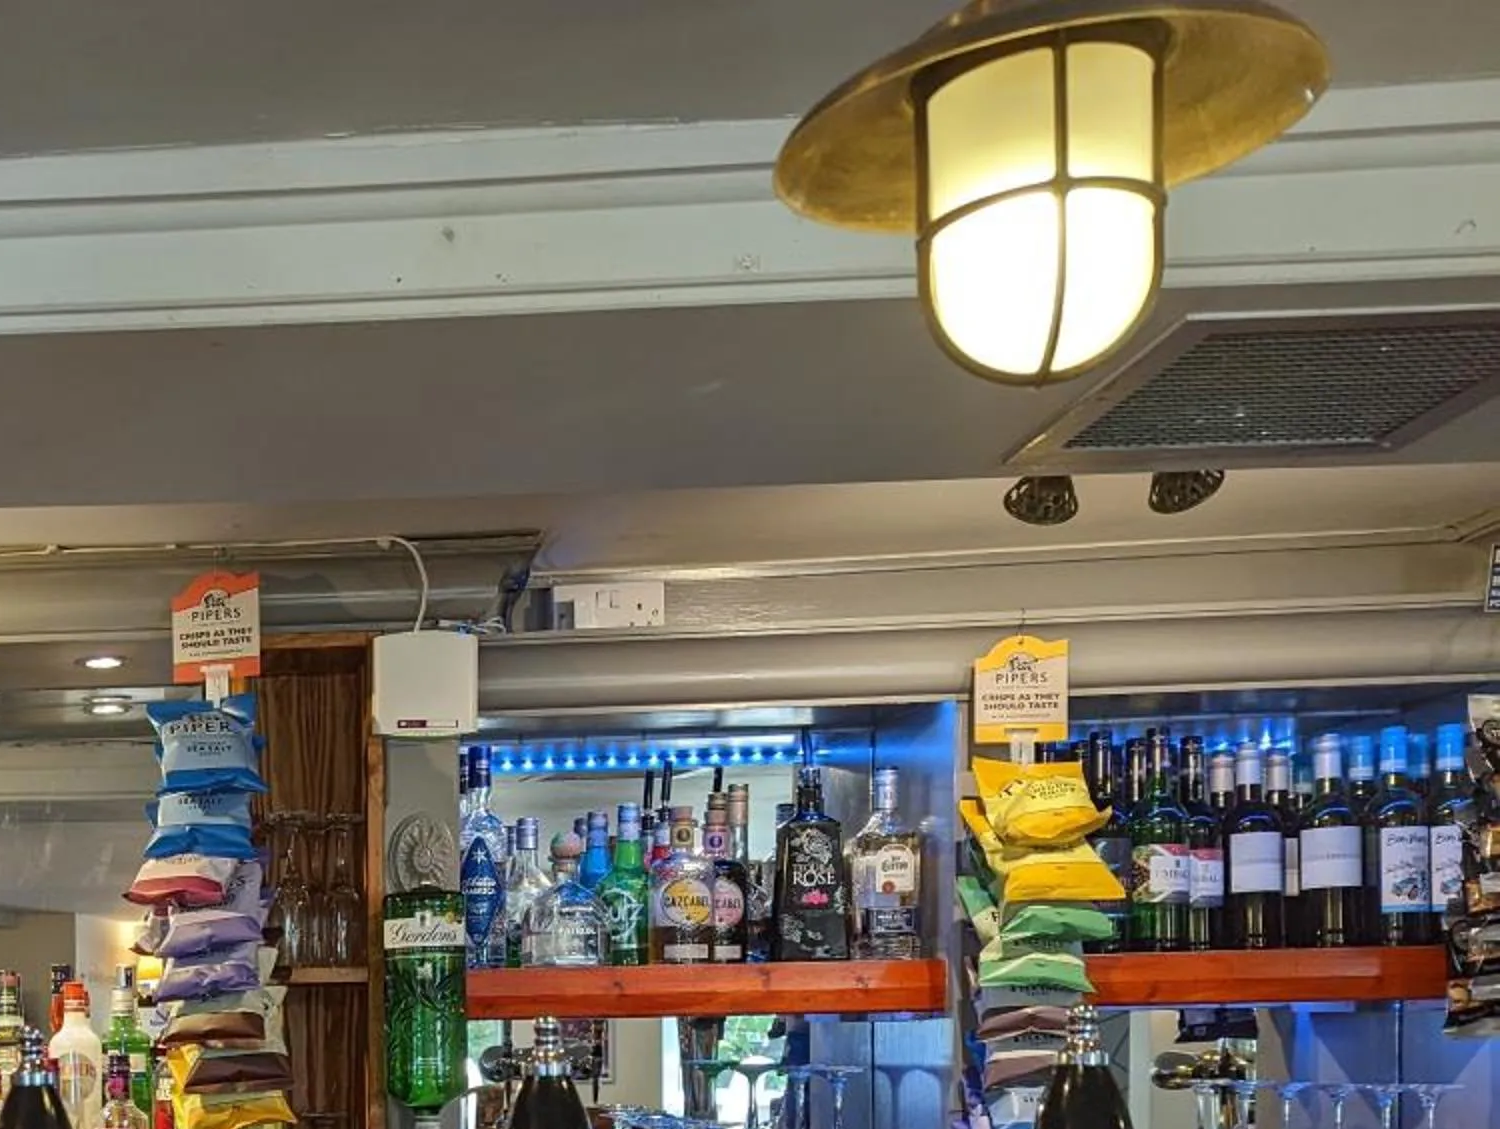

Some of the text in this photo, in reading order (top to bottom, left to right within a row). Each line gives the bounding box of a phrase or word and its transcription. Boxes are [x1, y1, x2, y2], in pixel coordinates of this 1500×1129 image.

[191, 608, 242, 622] PIPERS
[995, 671, 1049, 685] PIPERS
[169, 721, 238, 735] PIPER
[792, 870, 836, 886] ROSE
